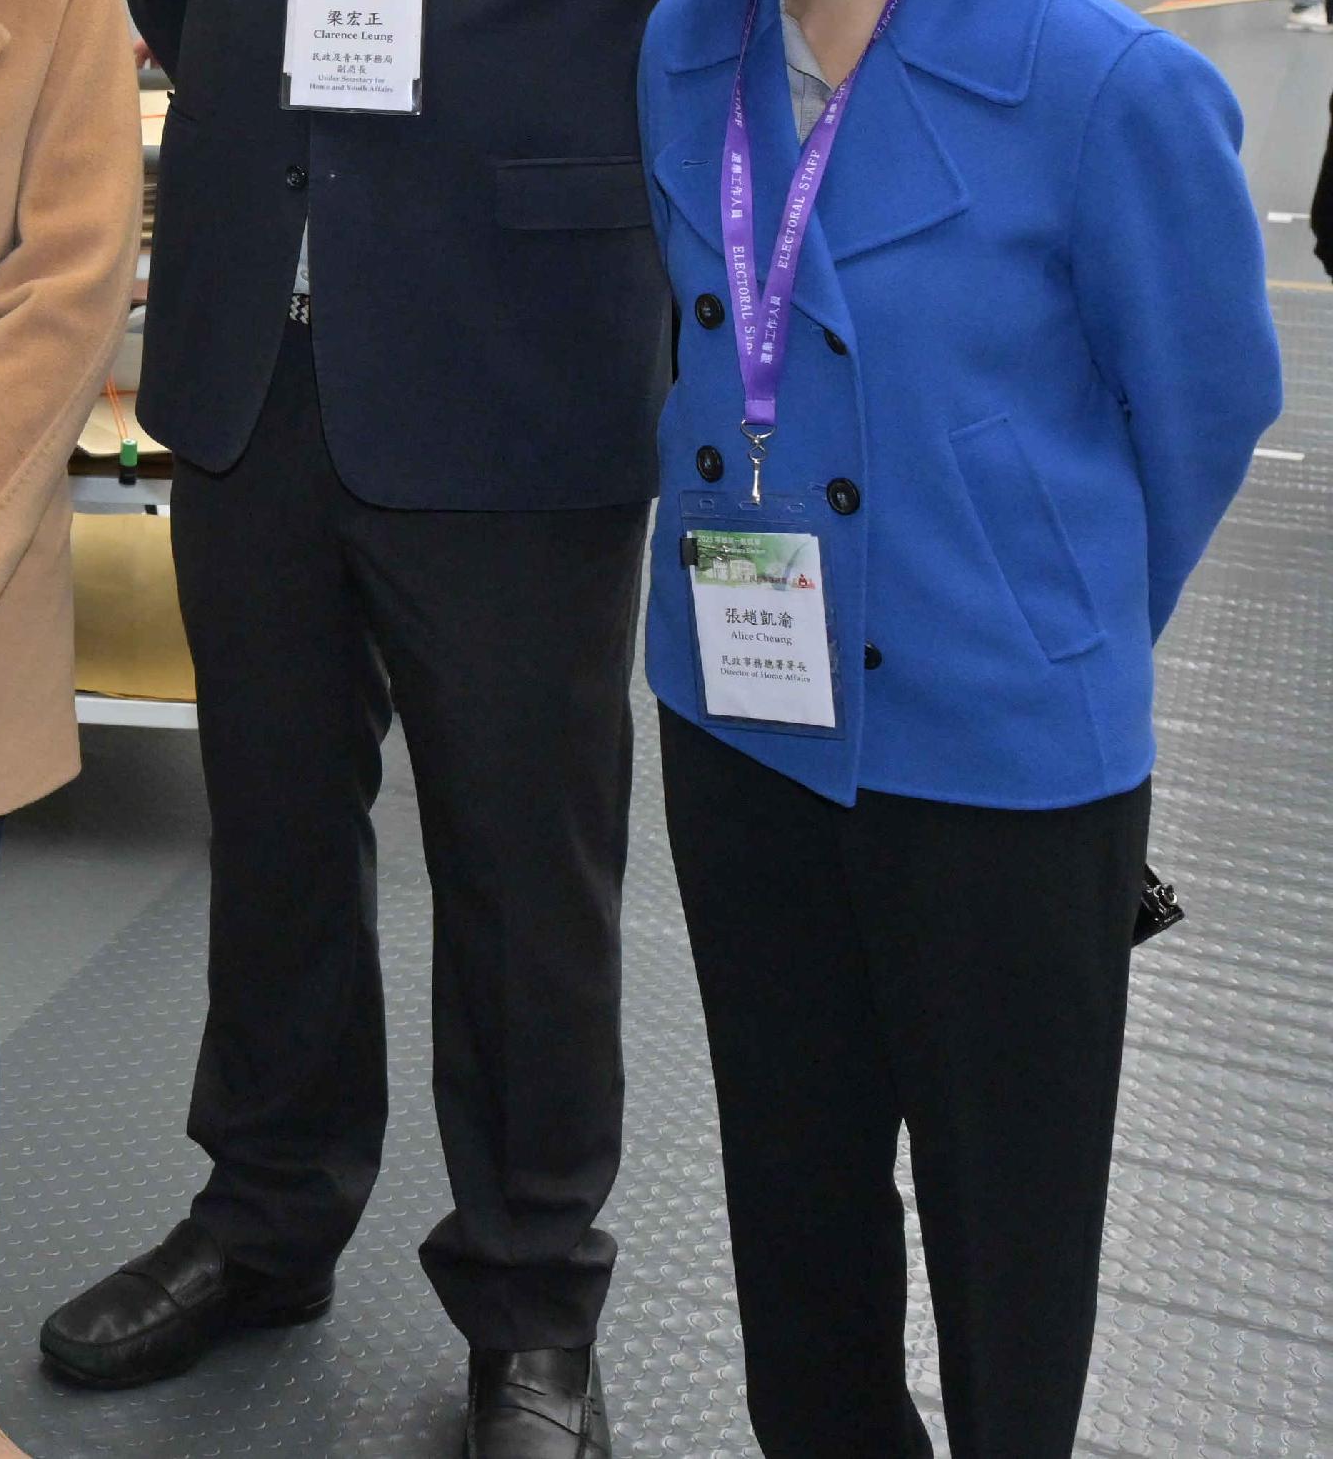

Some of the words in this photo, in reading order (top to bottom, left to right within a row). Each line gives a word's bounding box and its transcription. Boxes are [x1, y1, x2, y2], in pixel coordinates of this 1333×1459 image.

[326, 10, 384, 27] 梁宏正
[313, 29, 358, 41] Clarence
[361, 31, 394, 43] Leung
[777, 195, 806, 270] ELECTORAL
[798, 149, 821, 191] STAFF
[732, 245, 754, 320] ELECTORAL
[730, 631, 754, 641] Alice
[756, 633, 793, 646] Cheung
